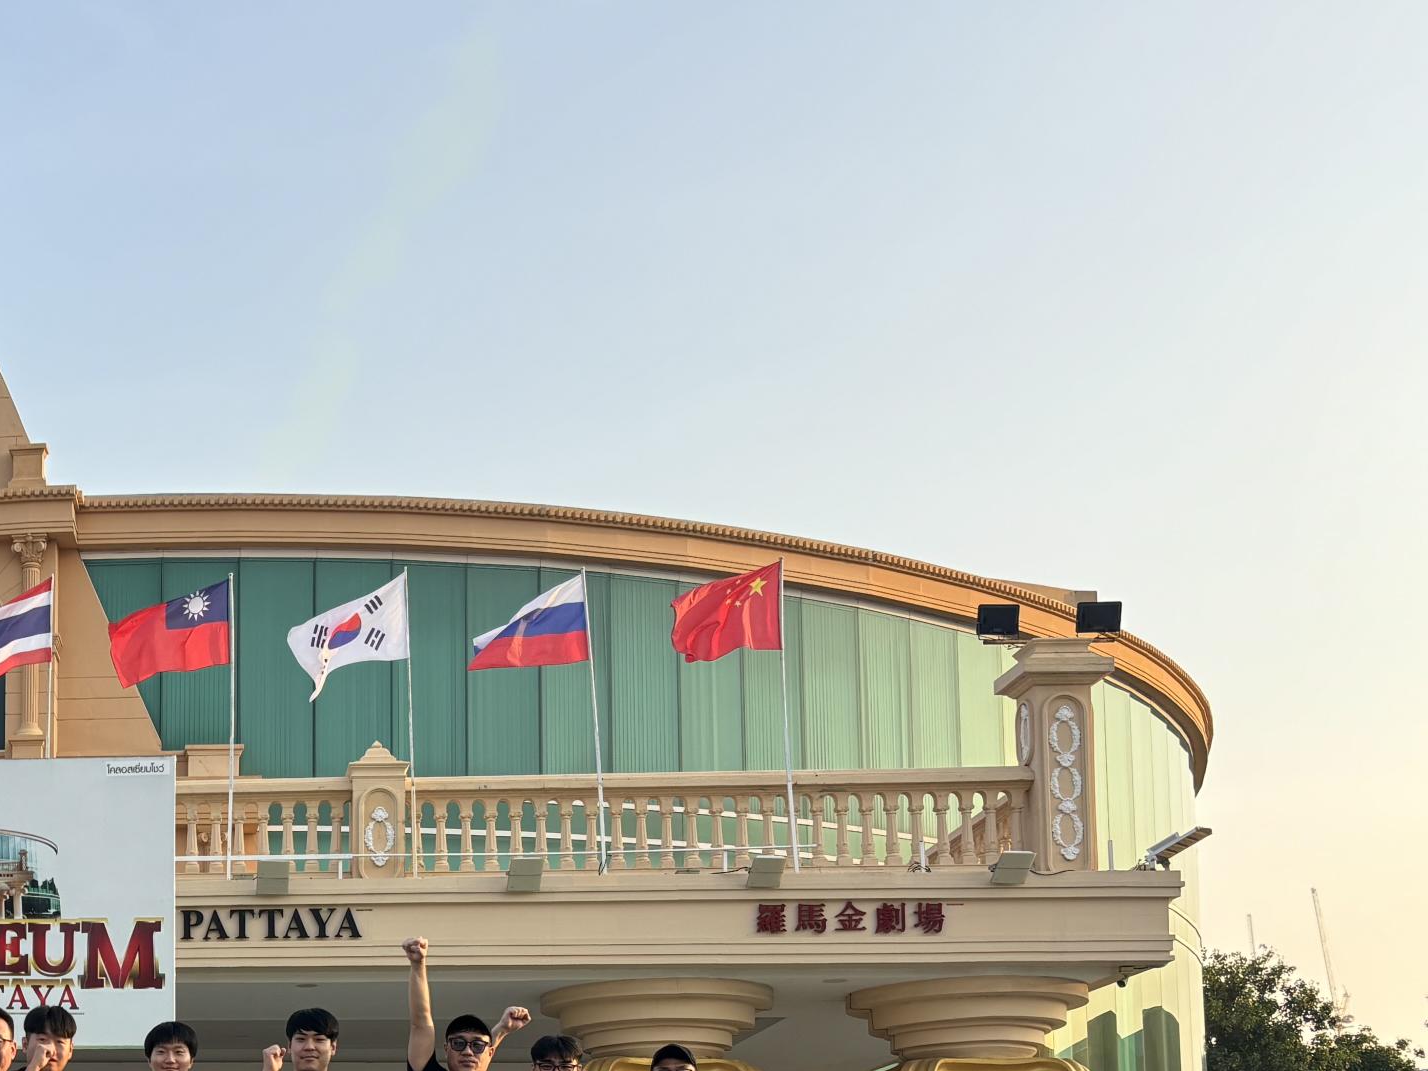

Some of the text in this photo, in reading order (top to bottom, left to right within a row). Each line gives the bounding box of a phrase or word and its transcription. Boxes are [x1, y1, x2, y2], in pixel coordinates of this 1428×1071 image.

[181, 906, 363, 941] PATTAYA
[756, 901, 946, 934] 羅馬金劇場
